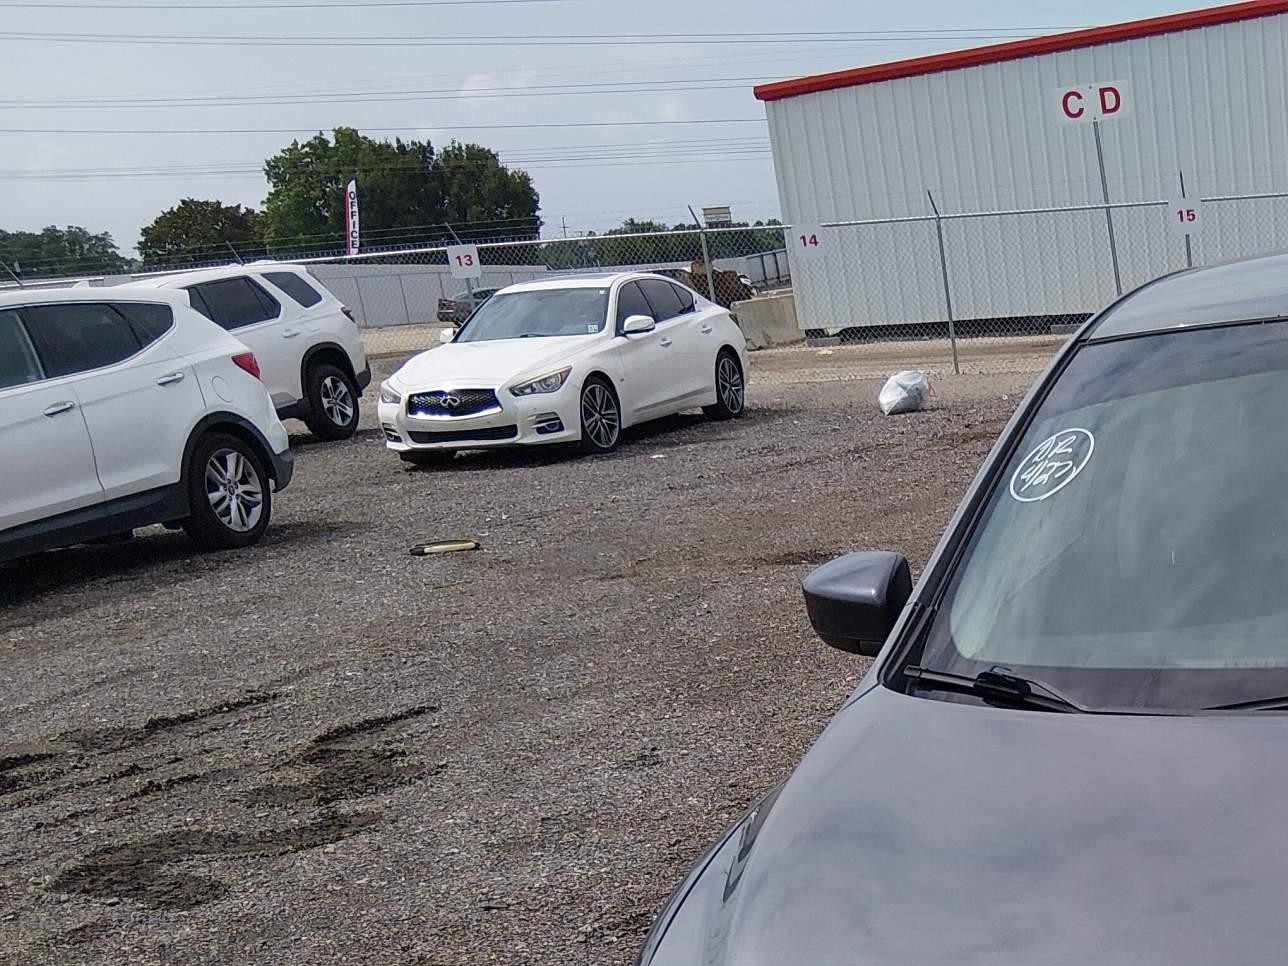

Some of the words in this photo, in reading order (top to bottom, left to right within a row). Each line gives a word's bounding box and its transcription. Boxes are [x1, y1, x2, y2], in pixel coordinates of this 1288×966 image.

[1062, 90, 1085, 119] C
[1099, 86, 1121, 115] D
[348, 191, 360, 249] OFFICE
[1177, 209, 1197, 223] 15
[799, 234, 820, 247] 14
[455, 254, 474, 267] 13
